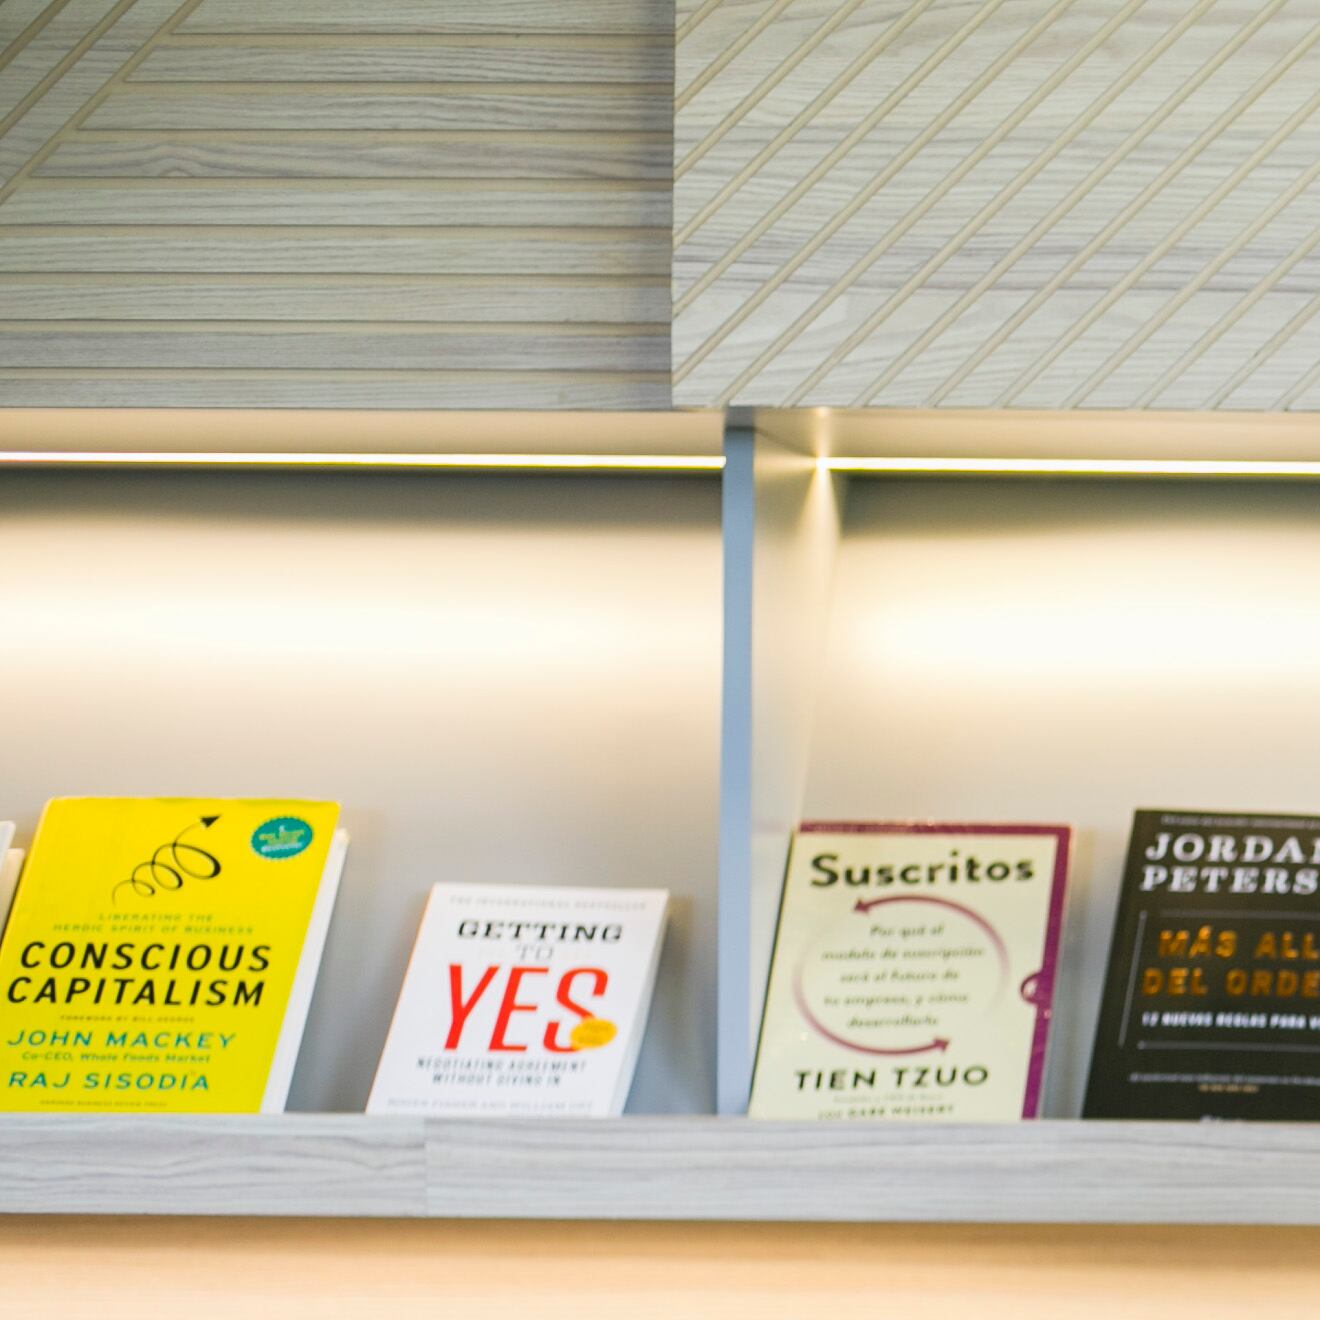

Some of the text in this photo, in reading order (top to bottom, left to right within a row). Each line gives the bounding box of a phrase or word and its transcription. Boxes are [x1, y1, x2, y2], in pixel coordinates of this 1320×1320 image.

[810, 850, 1035, 887] Suscritos
[457, 919, 623, 942] GETTING
[1158, 925, 1238, 959] MÁS
[20, 941, 272, 972] CONSCIOUS
[515, 943, 554, 961] TO
[7, 976, 266, 1007] CAPITALISM
[1142, 967, 1208, 997] DEL
[444, 964, 609, 1054] YES
[7, 1030, 236, 1049] JOHN MACKEY
[8, 1072, 209, 1090] RAJ SISODIA
[795, 1065, 989, 1090] TIEN TZUO
